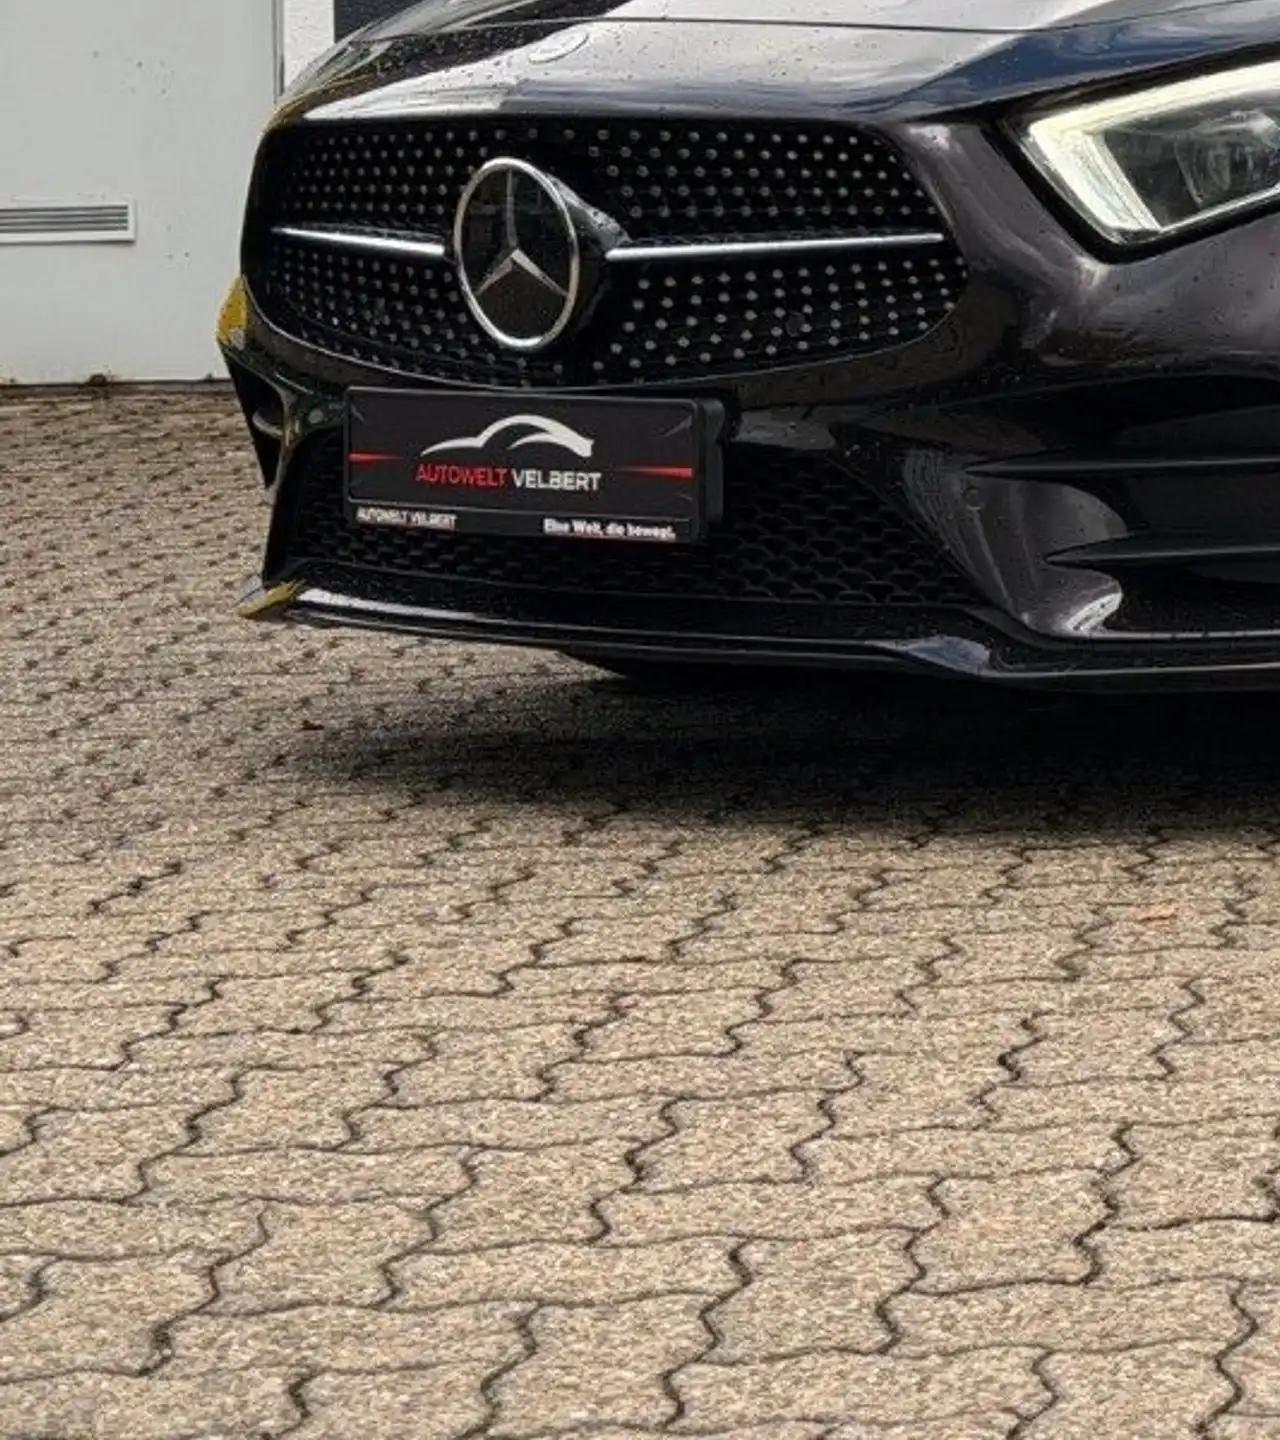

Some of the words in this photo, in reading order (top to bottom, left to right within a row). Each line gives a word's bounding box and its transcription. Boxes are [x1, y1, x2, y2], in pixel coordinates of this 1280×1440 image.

[415, 464, 507, 486] AUTOWELT
[511, 469, 602, 491] VELBERT
[356, 506, 408, 526] AUTOWELT
[409, 511, 457, 531] VELBERT
